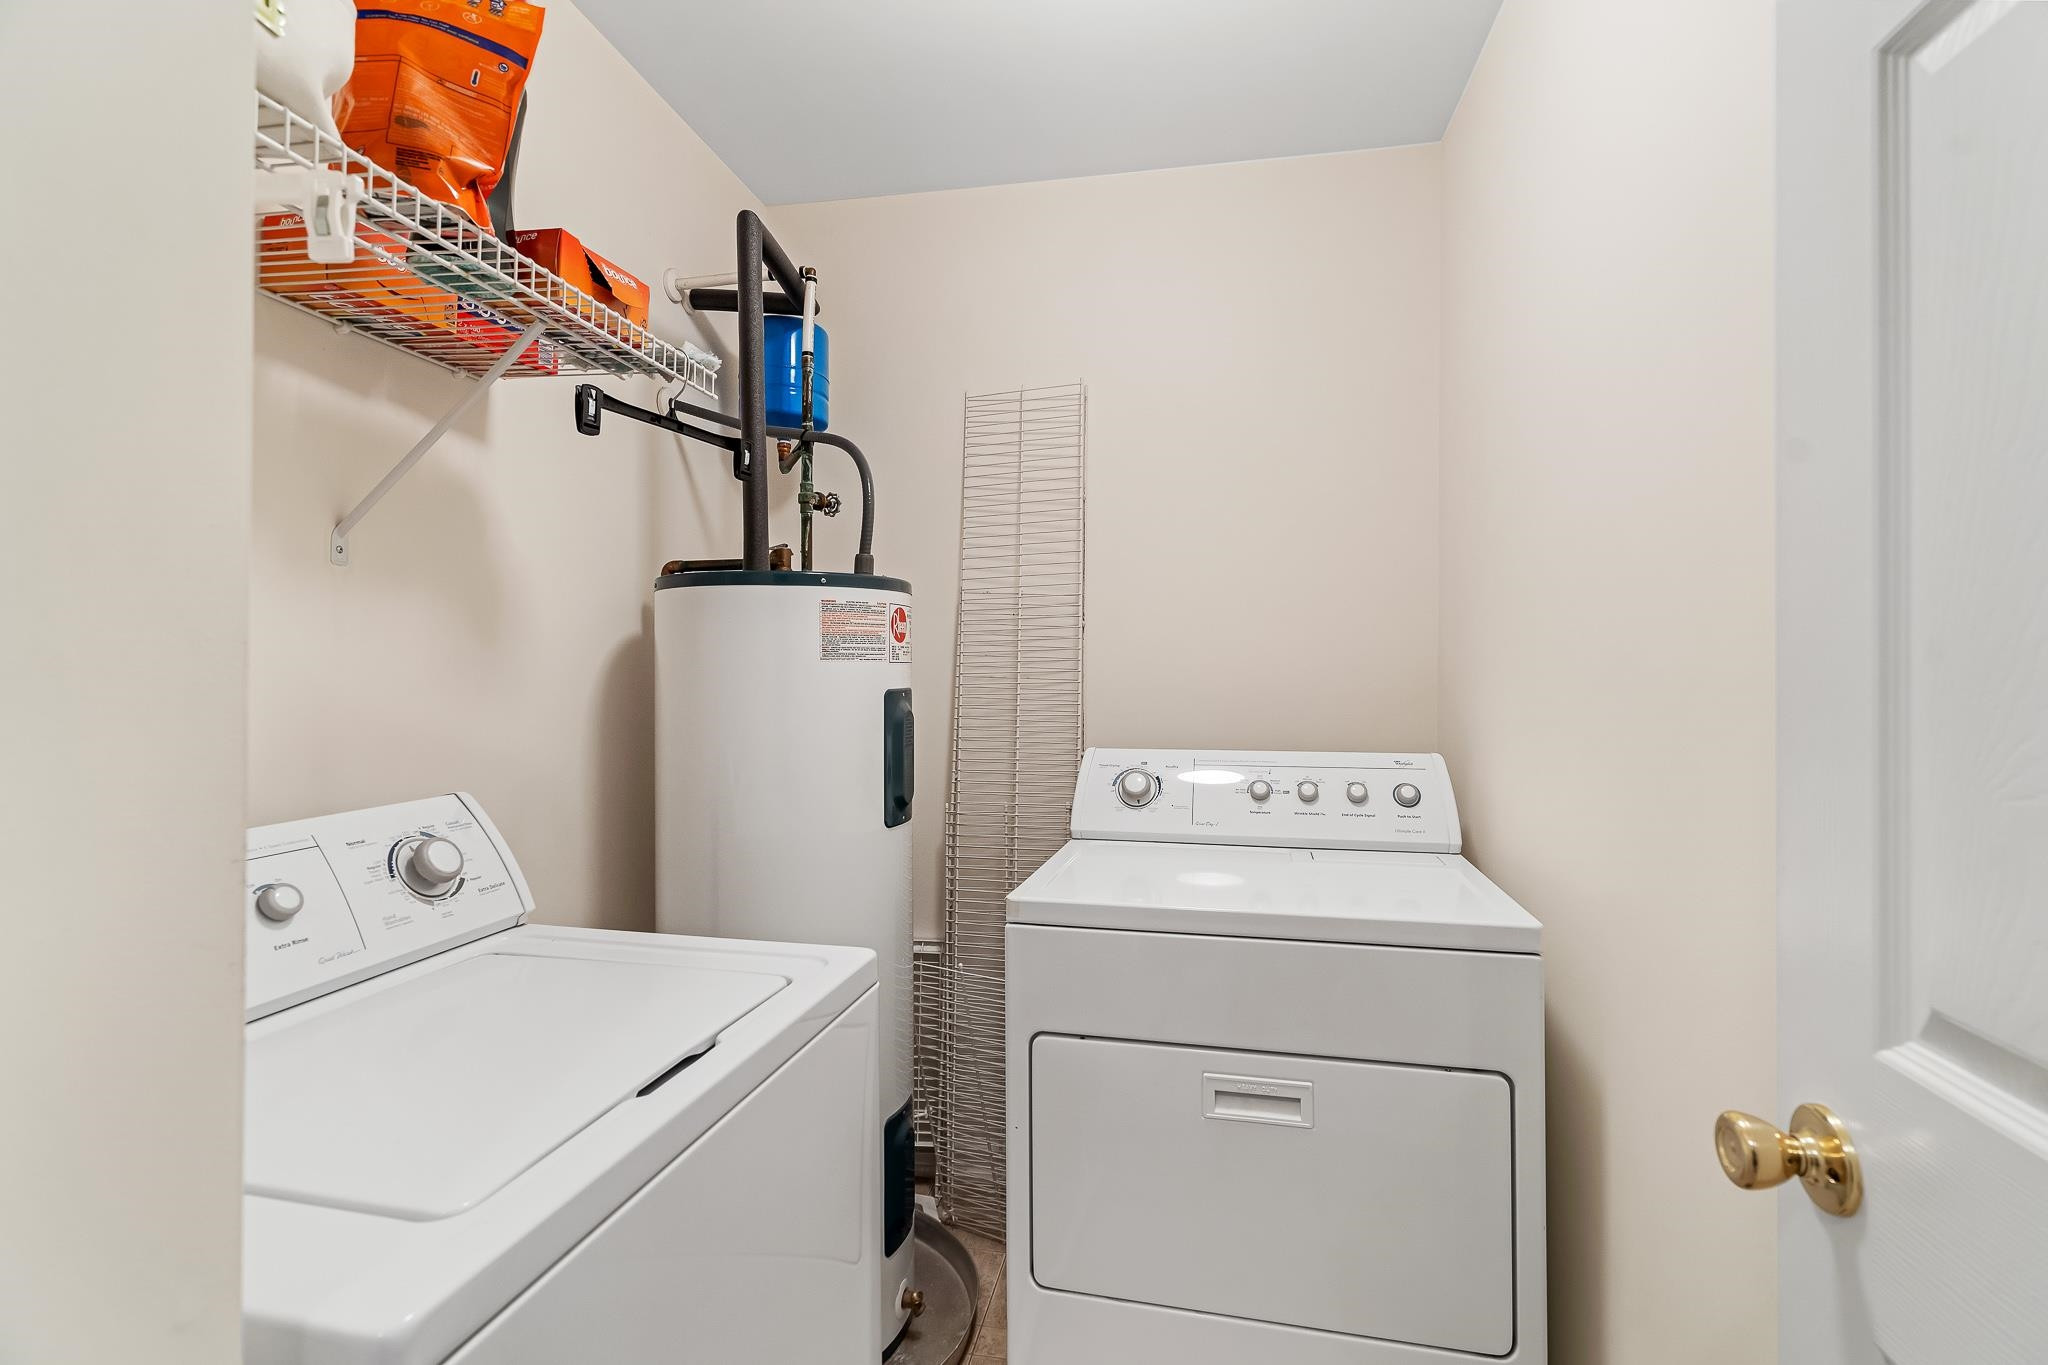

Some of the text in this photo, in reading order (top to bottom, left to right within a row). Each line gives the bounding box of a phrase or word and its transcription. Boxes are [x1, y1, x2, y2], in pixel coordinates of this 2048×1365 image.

[280, 215, 305, 227] bounc
[516, 232, 538, 243] unce
[601, 262, 638, 290] bounce
[273, 937, 309, 951] Extra Rinse
